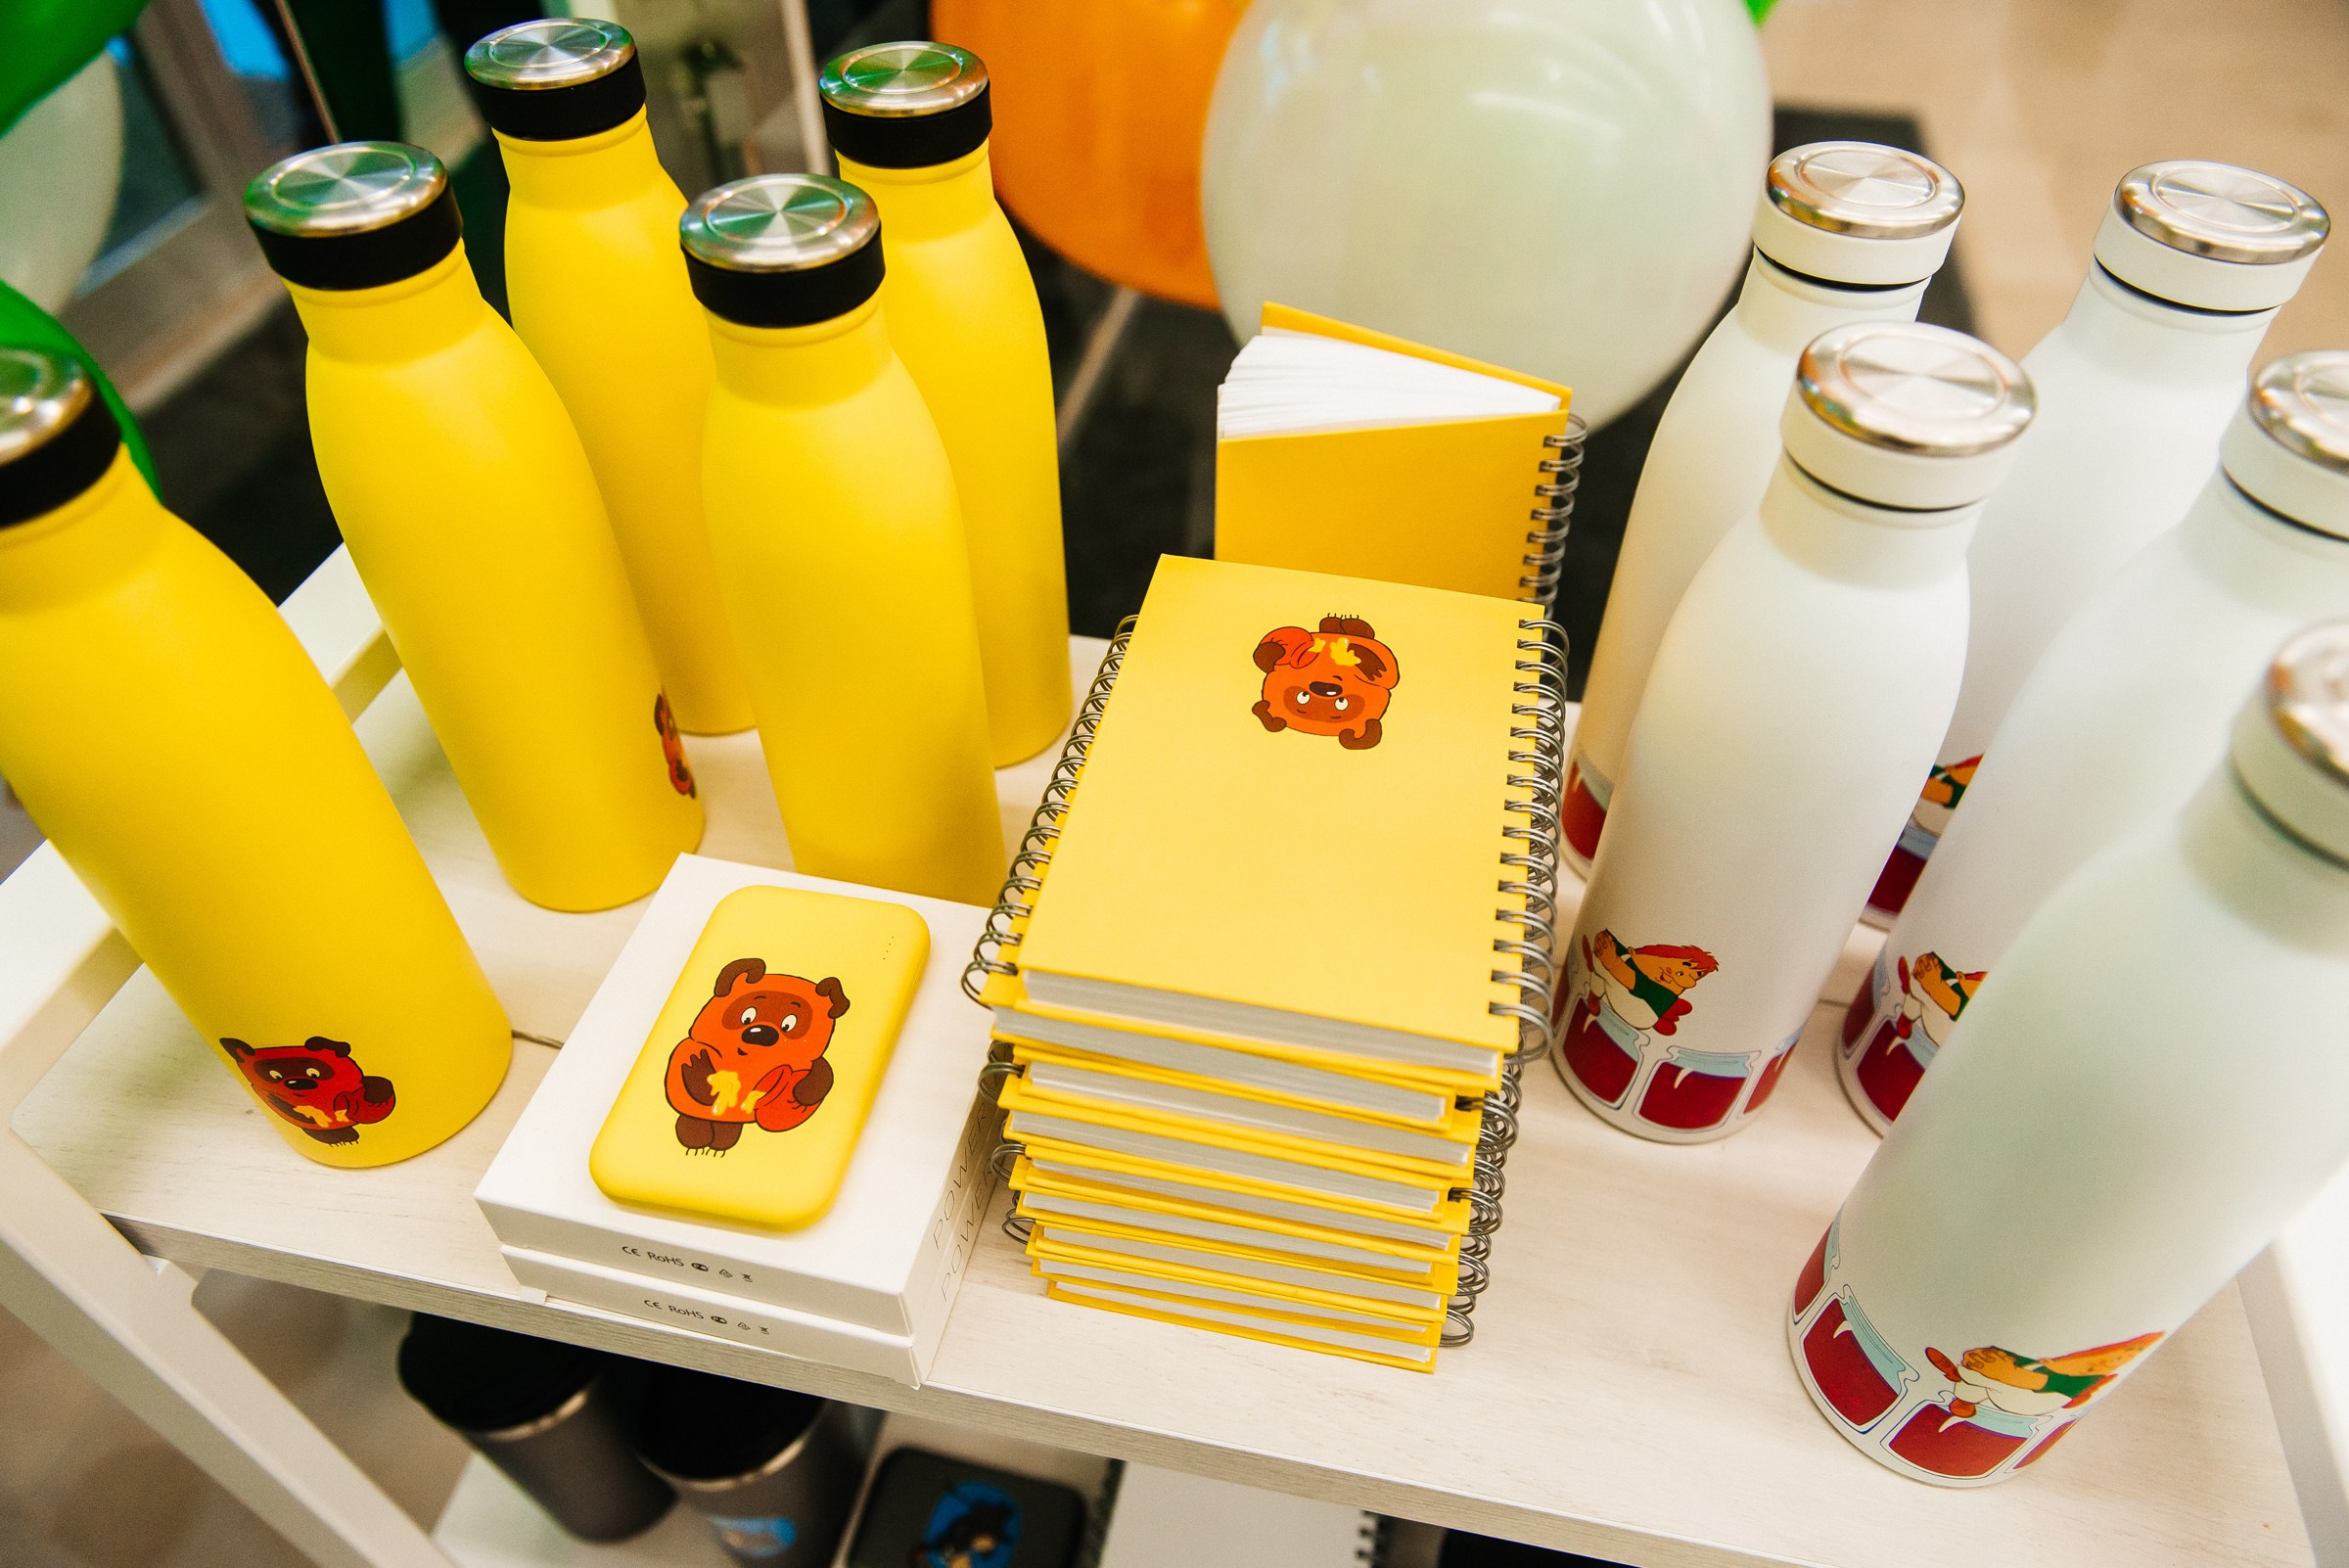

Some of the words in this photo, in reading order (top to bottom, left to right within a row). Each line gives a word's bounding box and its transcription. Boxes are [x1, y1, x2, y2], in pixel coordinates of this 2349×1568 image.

[933, 1101, 988, 1251] POWER
[647, 1251, 684, 1267] RoHS
[668, 1305, 704, 1319] RoHS
